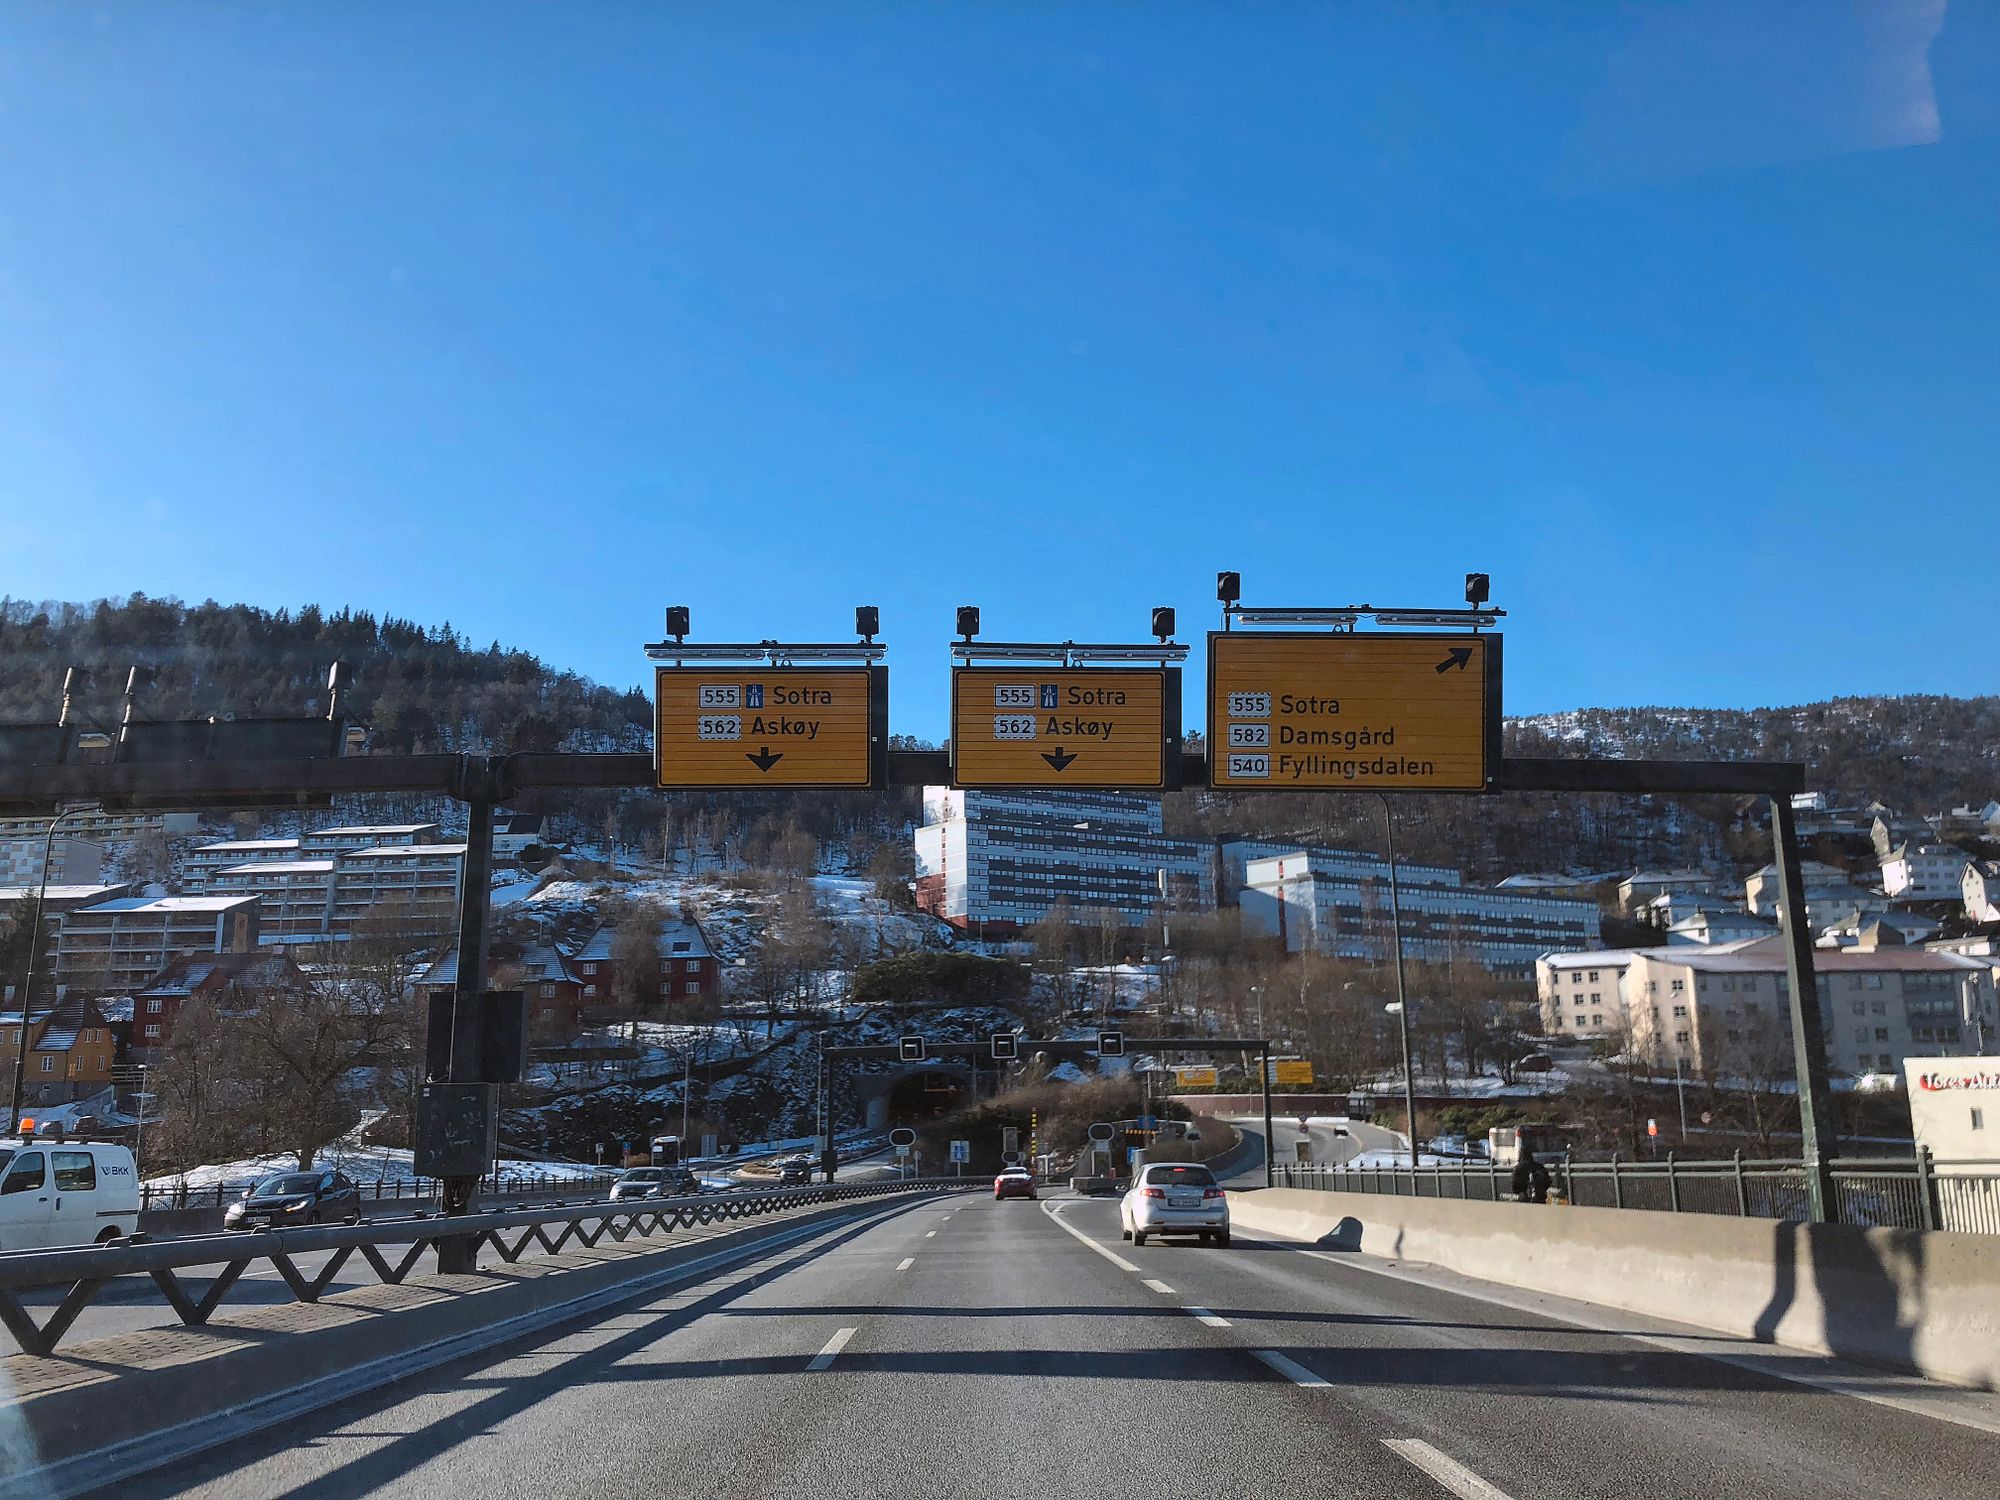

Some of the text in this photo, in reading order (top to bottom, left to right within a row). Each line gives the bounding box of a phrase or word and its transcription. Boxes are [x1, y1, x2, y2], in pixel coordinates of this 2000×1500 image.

[704, 686, 832, 705] 555 Sotra
[1000, 686, 1126, 705] 555 Sotra
[1234, 695, 1340, 714] 555 Sotra
[704, 716, 820, 740] 562 Askøy
[999, 716, 1113, 740] 562 Askøy
[1233, 726, 1395, 750] 582 Damsgård
[1233, 755, 1434, 779] 540 Fyllingsdalen
[111, 1166, 129, 1175] BKK
